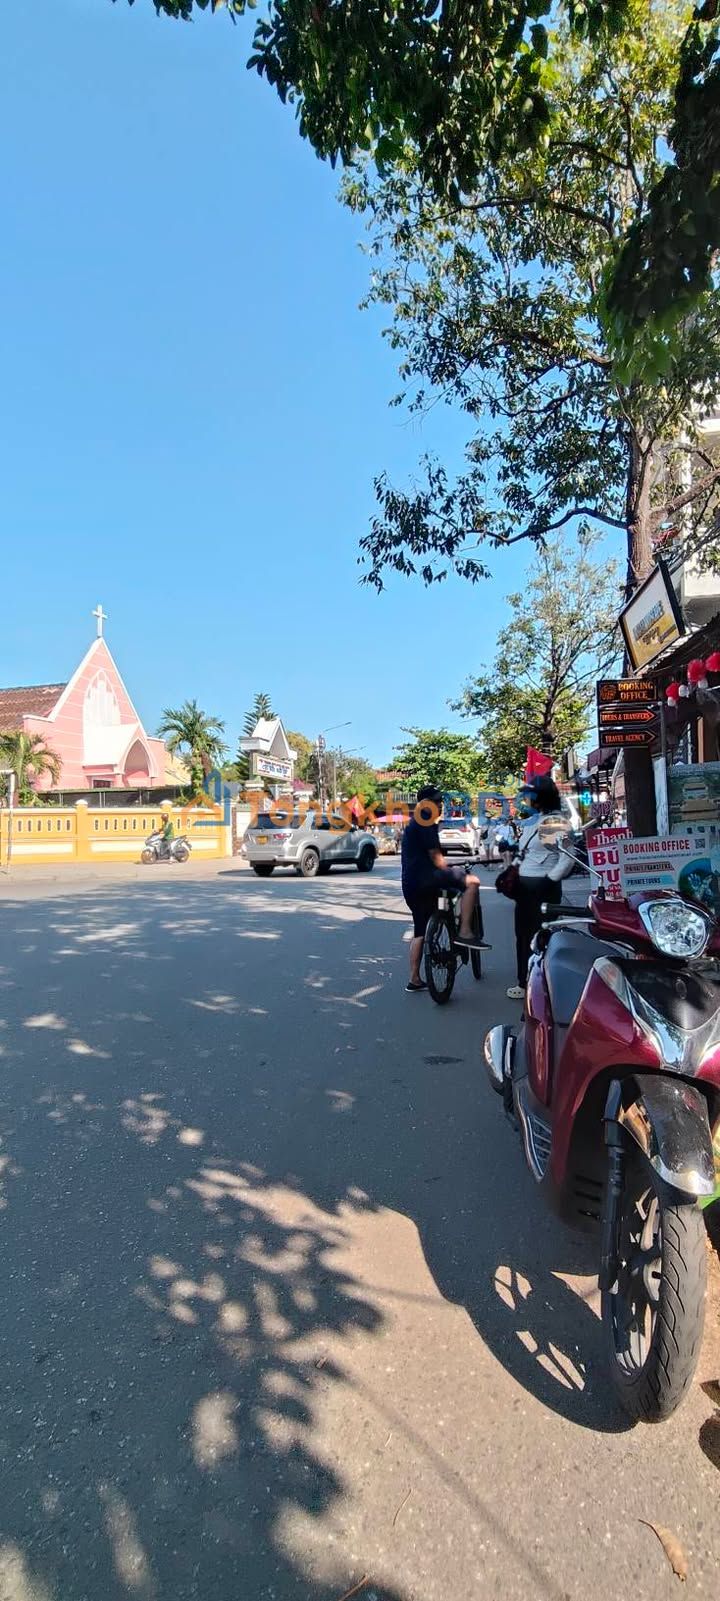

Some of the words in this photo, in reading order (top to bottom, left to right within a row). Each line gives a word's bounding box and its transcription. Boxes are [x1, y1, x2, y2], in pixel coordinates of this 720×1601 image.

[618, 682, 653, 691] BOOKING
[620, 691, 648, 700] OFFICE
[623, 712, 650, 721] TRANSFERS
[605, 735, 624, 743] TRAVEL
[625, 734, 646, 742] AGENCY
[623, 842, 660, 855] BOOKING
[661, 840, 690, 852] OFFICE
